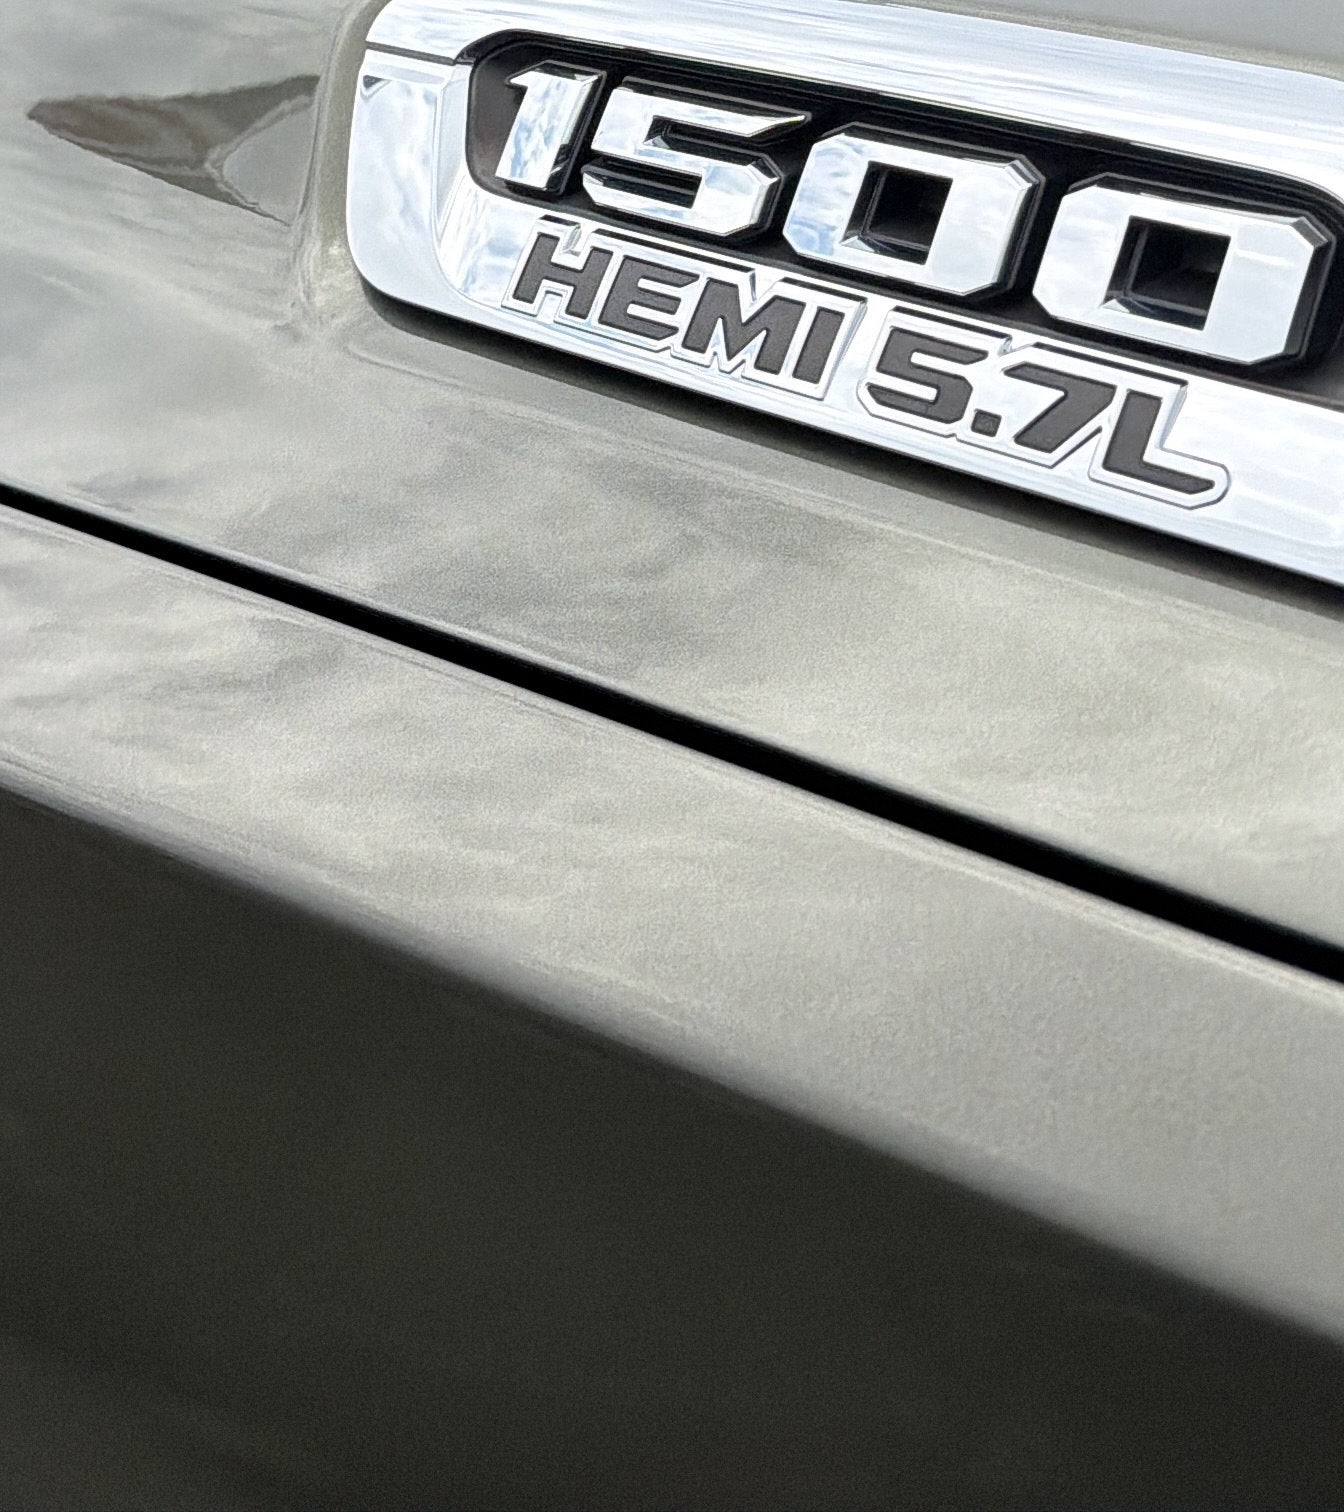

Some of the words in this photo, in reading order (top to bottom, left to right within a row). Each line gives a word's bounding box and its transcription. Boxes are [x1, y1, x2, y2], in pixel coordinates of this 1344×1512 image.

[493, 59, 1331, 365] 1500
[510, 230, 847, 387] HEMI
[864, 324, 1217, 496] 5.7L
